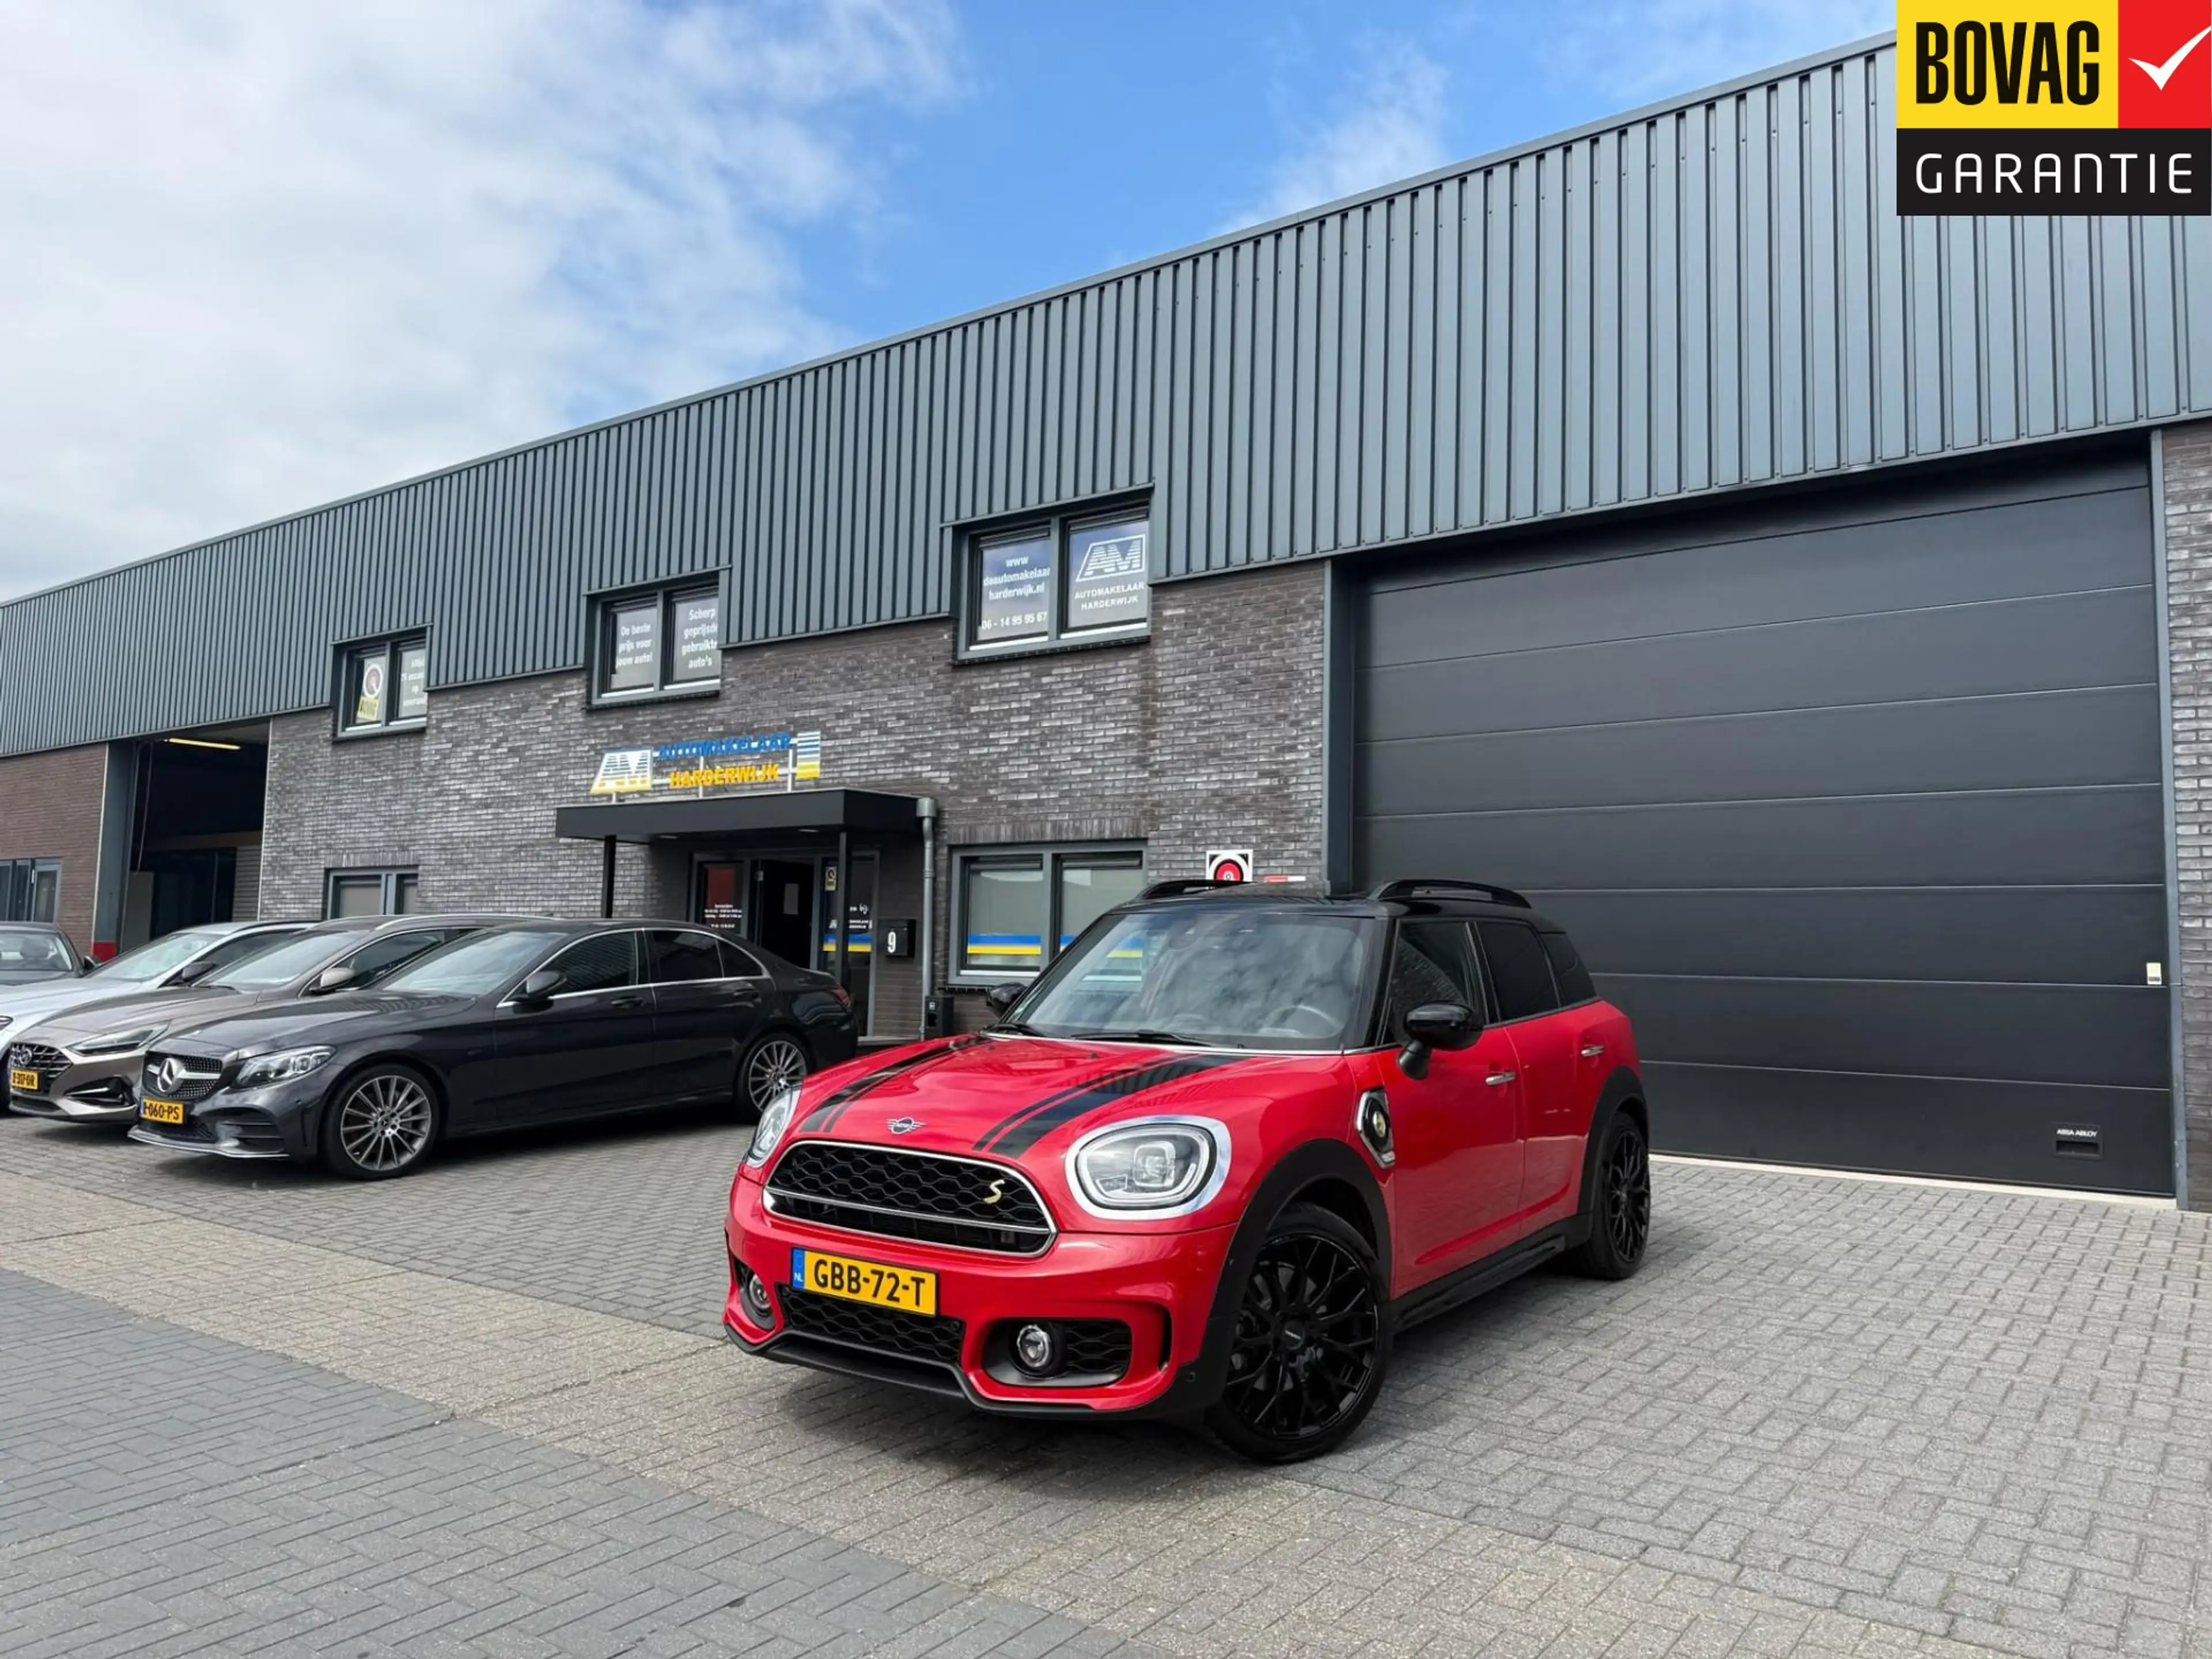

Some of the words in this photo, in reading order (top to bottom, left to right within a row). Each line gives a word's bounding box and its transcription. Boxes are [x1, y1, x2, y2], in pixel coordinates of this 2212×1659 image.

[1006, 556, 1029, 567] www
[983, 567, 1051, 586] deautomakelaar
[988, 581, 1045, 600] harderwijk.nl
[1074, 581, 1145, 600] AUTOMAKELAAR
[1081, 595, 1139, 611] HARDERWIJK
[689, 608, 715, 620] Scherp
[658, 732, 791, 760] AUTOMAKELAAR
[669, 762, 779, 789] HARDERWIJK
[888, 931, 896, 953] 9
[983, 1179, 1005, 1204] S
[794, 1272, 804, 1282] NL
[814, 1259, 926, 1308] GBB-72-T
